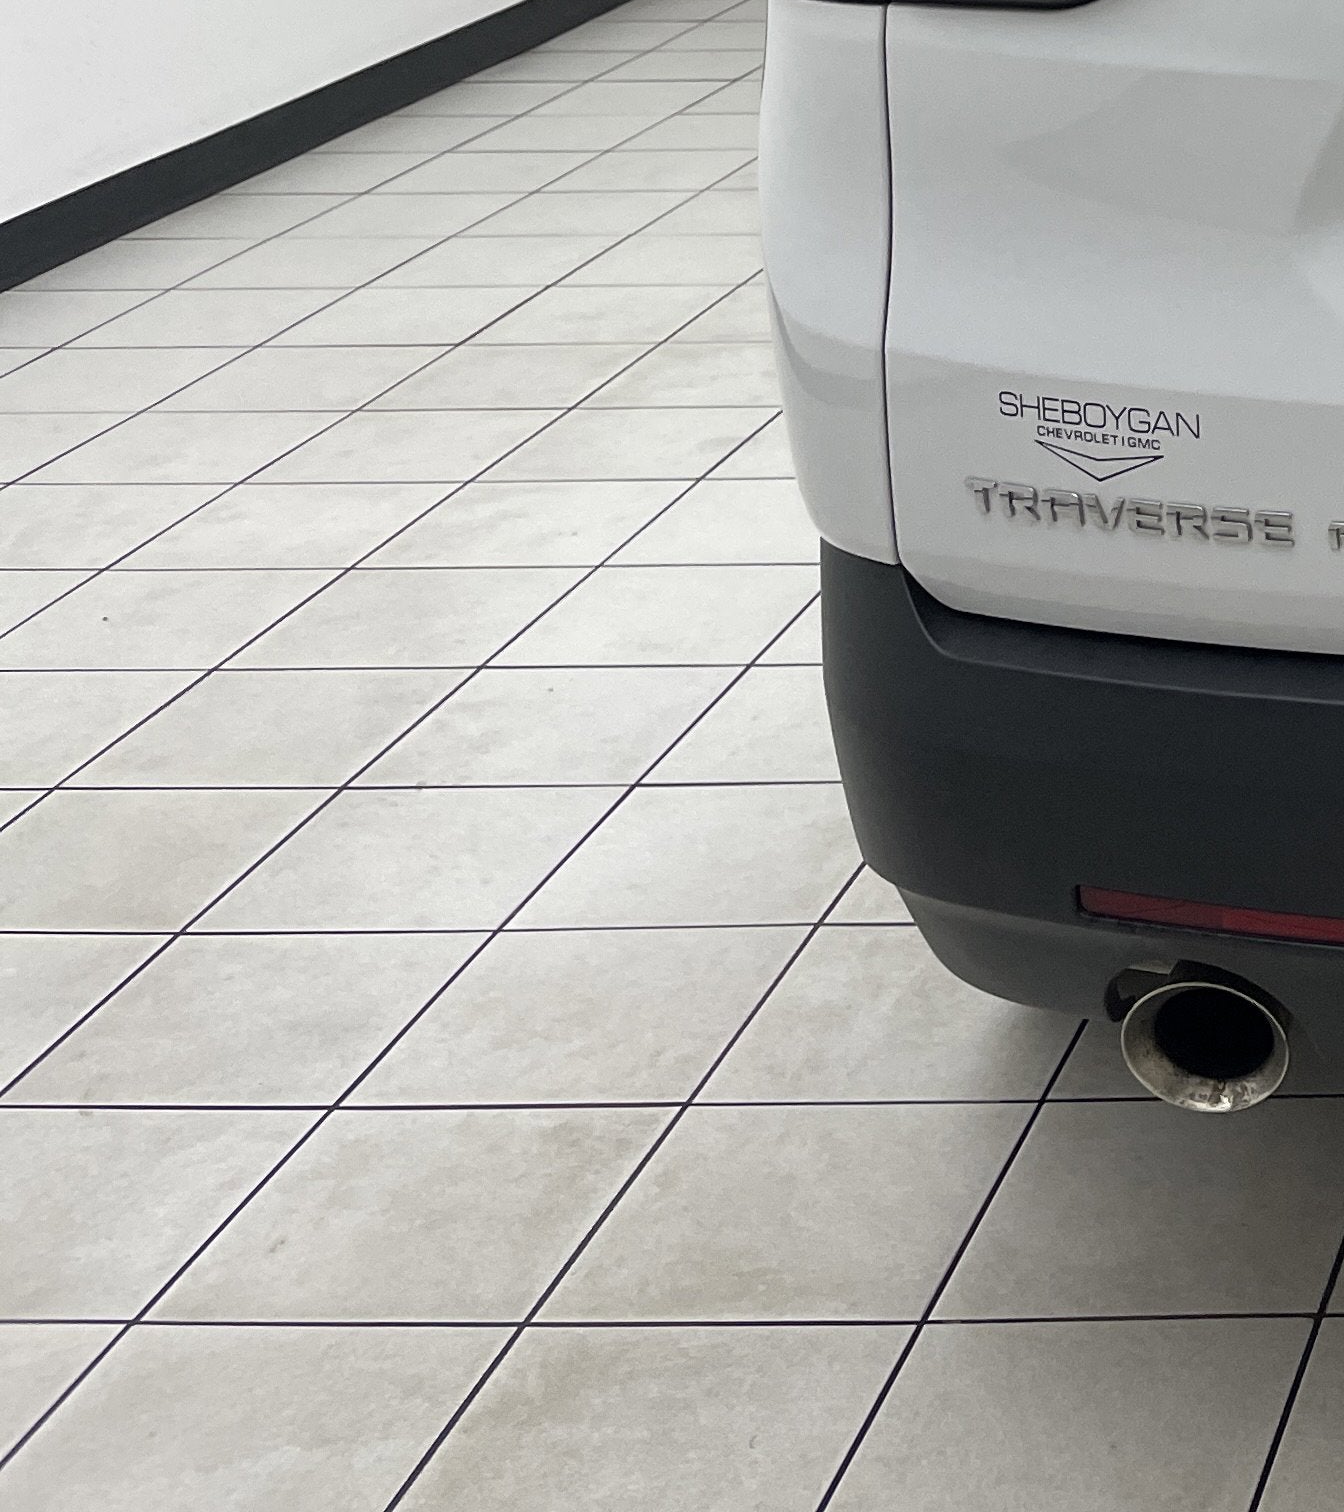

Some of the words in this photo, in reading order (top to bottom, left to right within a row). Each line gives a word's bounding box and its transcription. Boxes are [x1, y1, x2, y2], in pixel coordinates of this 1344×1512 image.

[998, 391, 1201, 439] SHEBOYGAN
[1036, 425, 1119, 446] CHEVROLET
[1127, 436, 1162, 451] GMC
[965, 475, 1295, 548] TRAVERSE
